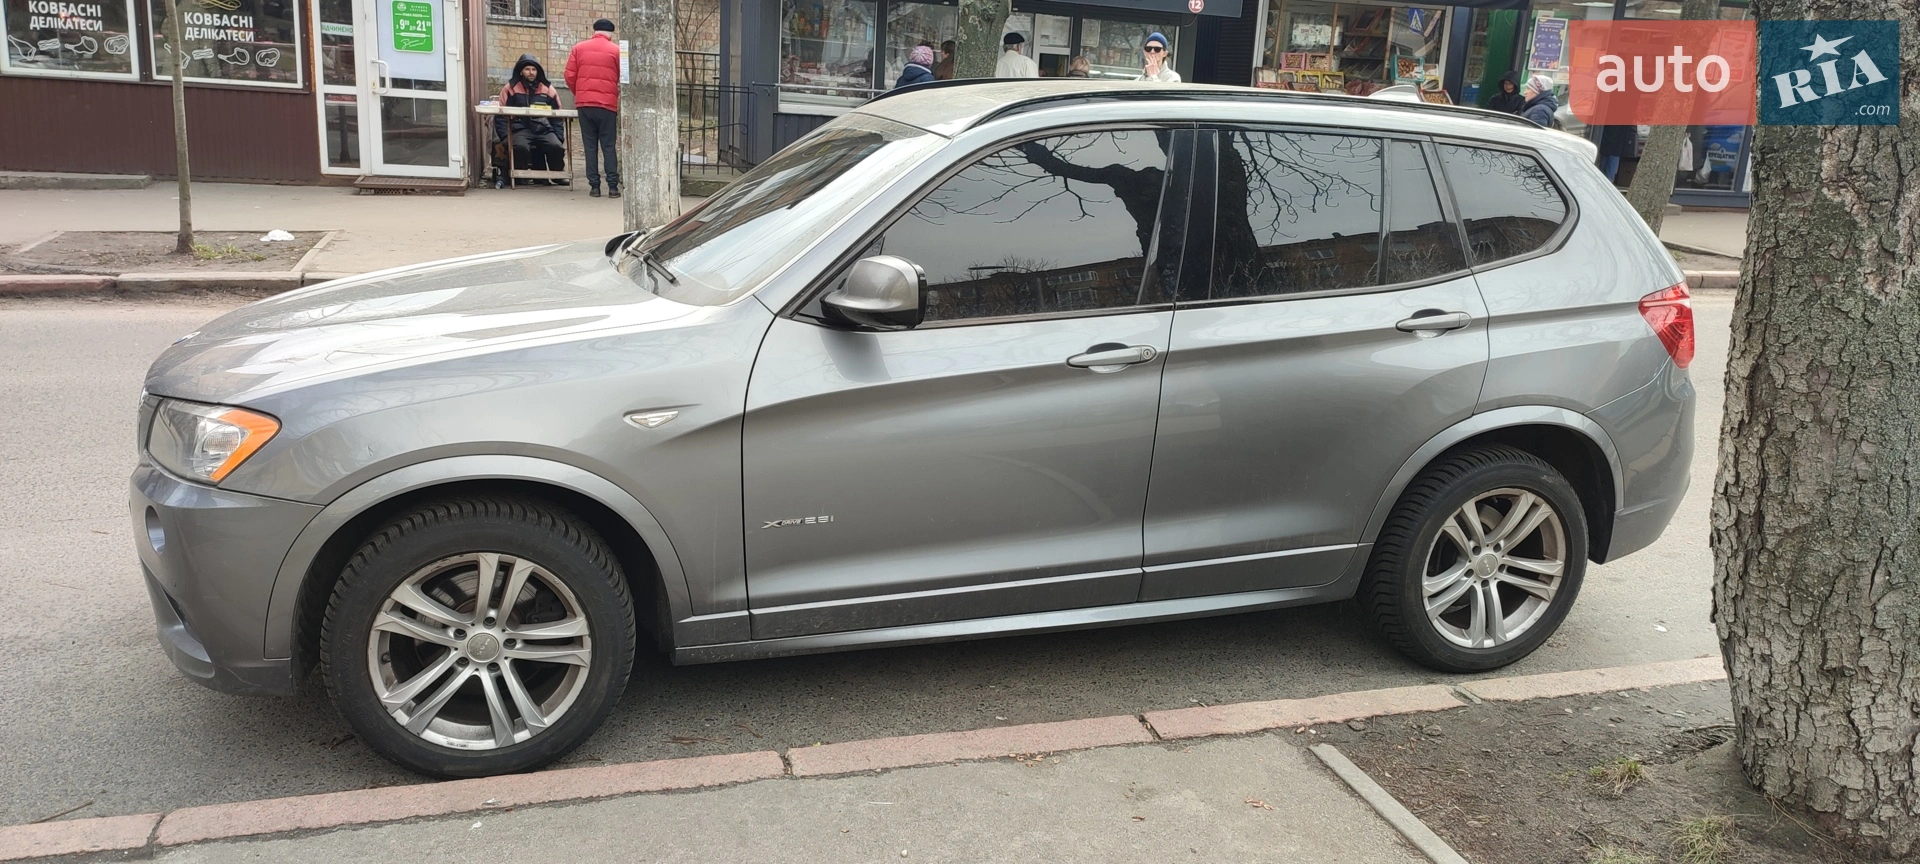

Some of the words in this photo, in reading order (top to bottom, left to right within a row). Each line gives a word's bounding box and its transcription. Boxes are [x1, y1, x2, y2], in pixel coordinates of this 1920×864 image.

[28, 1, 101, 17] КОВБАСНІ
[1190, 0, 1202, 9] 12
[29, 16, 103, 31] ДЕЛІКАТЕСИ
[184, 12, 253, 28] КОВБАСНІ
[185, 27, 254, 42] ДЕЛІКАТЕСИ
